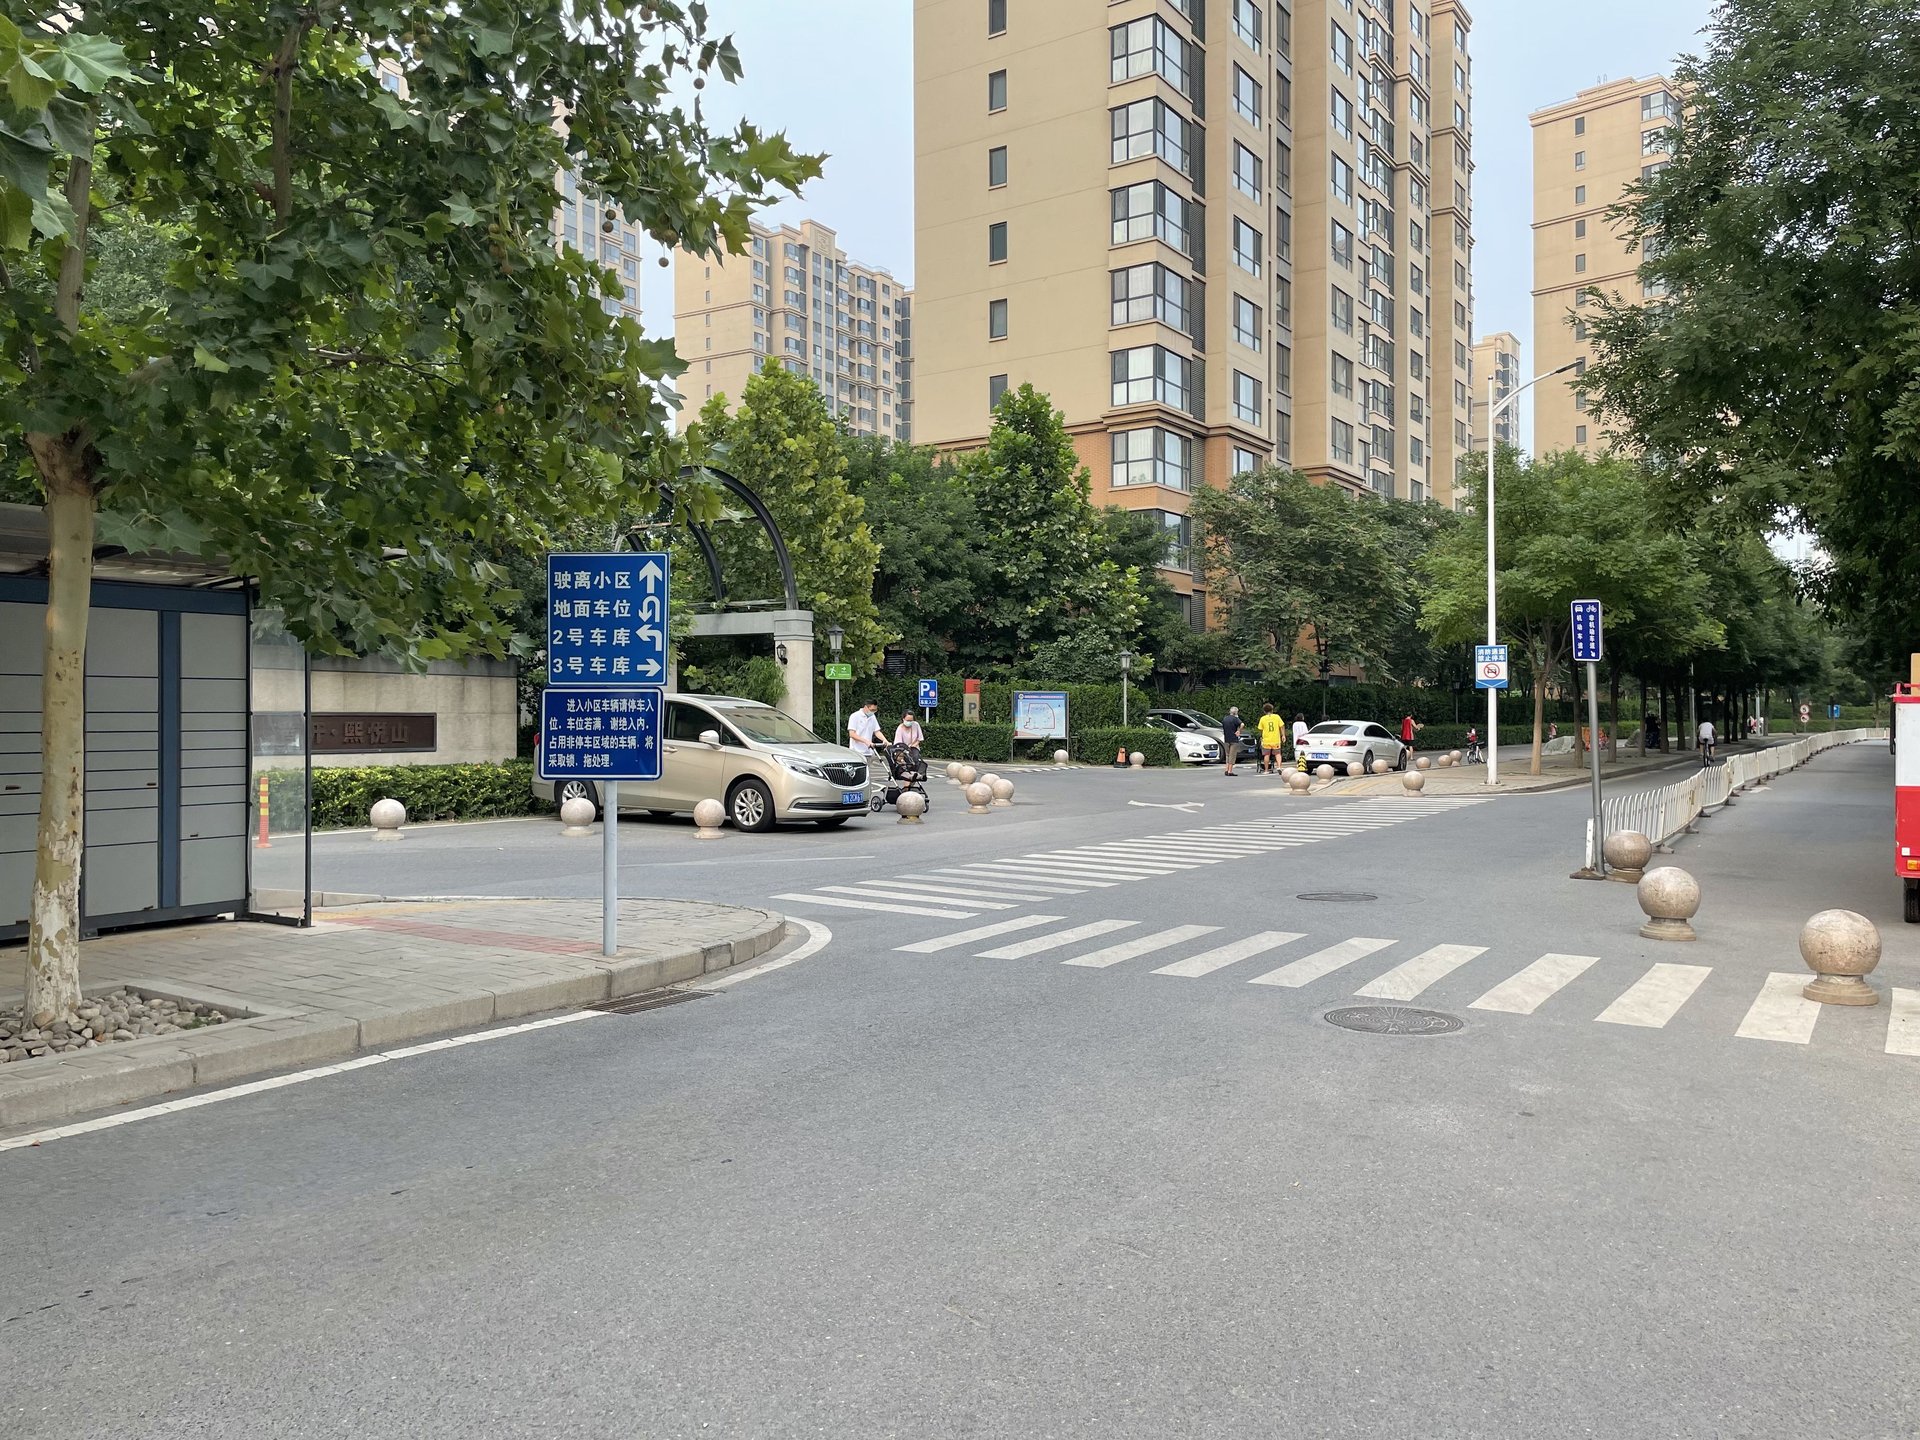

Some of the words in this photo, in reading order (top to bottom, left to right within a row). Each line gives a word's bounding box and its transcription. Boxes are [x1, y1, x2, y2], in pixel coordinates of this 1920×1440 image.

[554, 571, 631, 589] 驶离小区
[554, 600, 631, 618] 地面车位
[553, 628, 631, 647] 2号车库
[553, 656, 631, 675] 3号车库
[920, 682, 930, 697] P
[566, 698, 655, 713] 进入小区车辆请停车入
[968, 702, 977, 714] P
